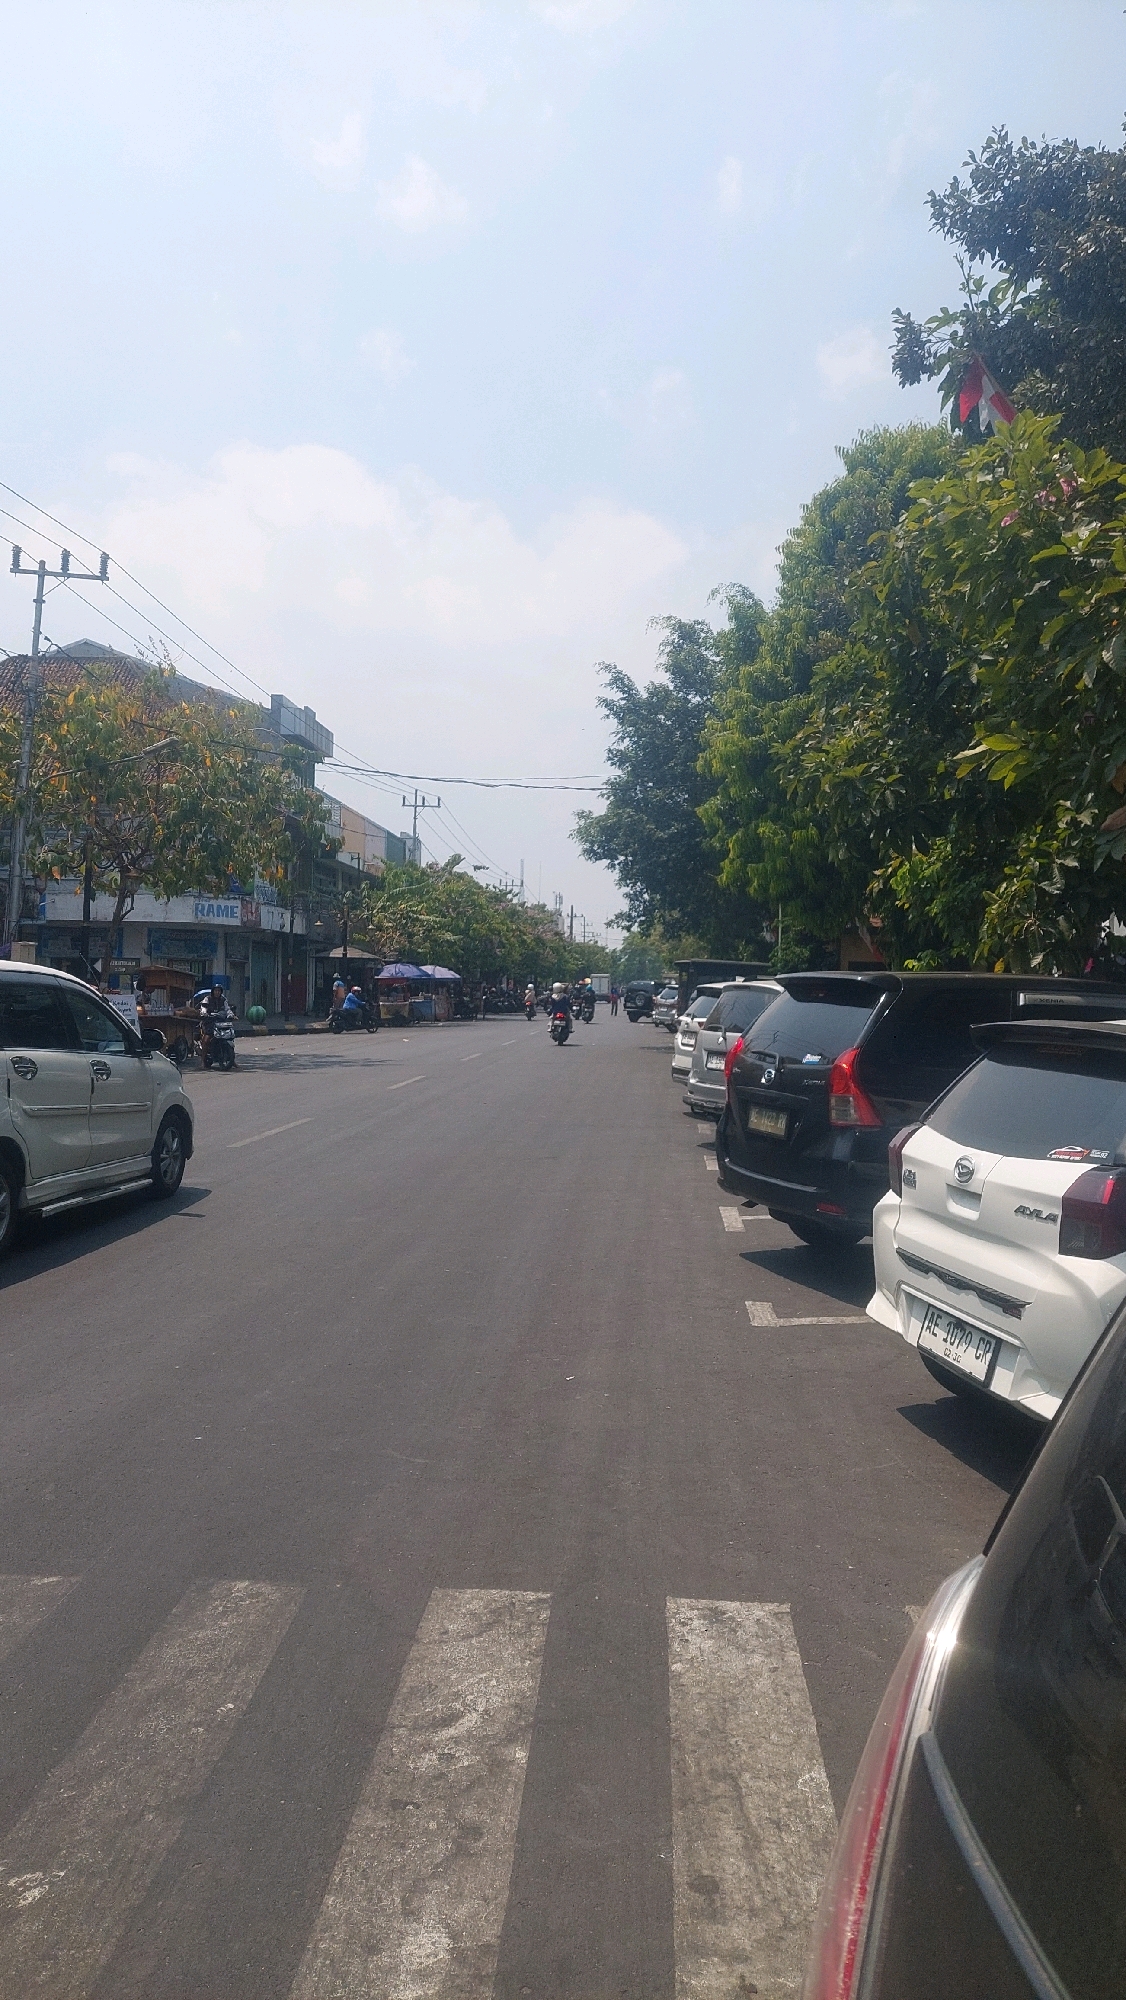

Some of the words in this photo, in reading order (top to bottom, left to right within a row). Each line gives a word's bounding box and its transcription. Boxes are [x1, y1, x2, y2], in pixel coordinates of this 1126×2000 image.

[195, 903, 238, 918] RAME
[1014, 1205, 1059, 1222] AYLA
[925, 1311, 942, 1338] AE
[943, 1321, 973, 1353] 1079
[975, 1337, 992, 1365] CR
